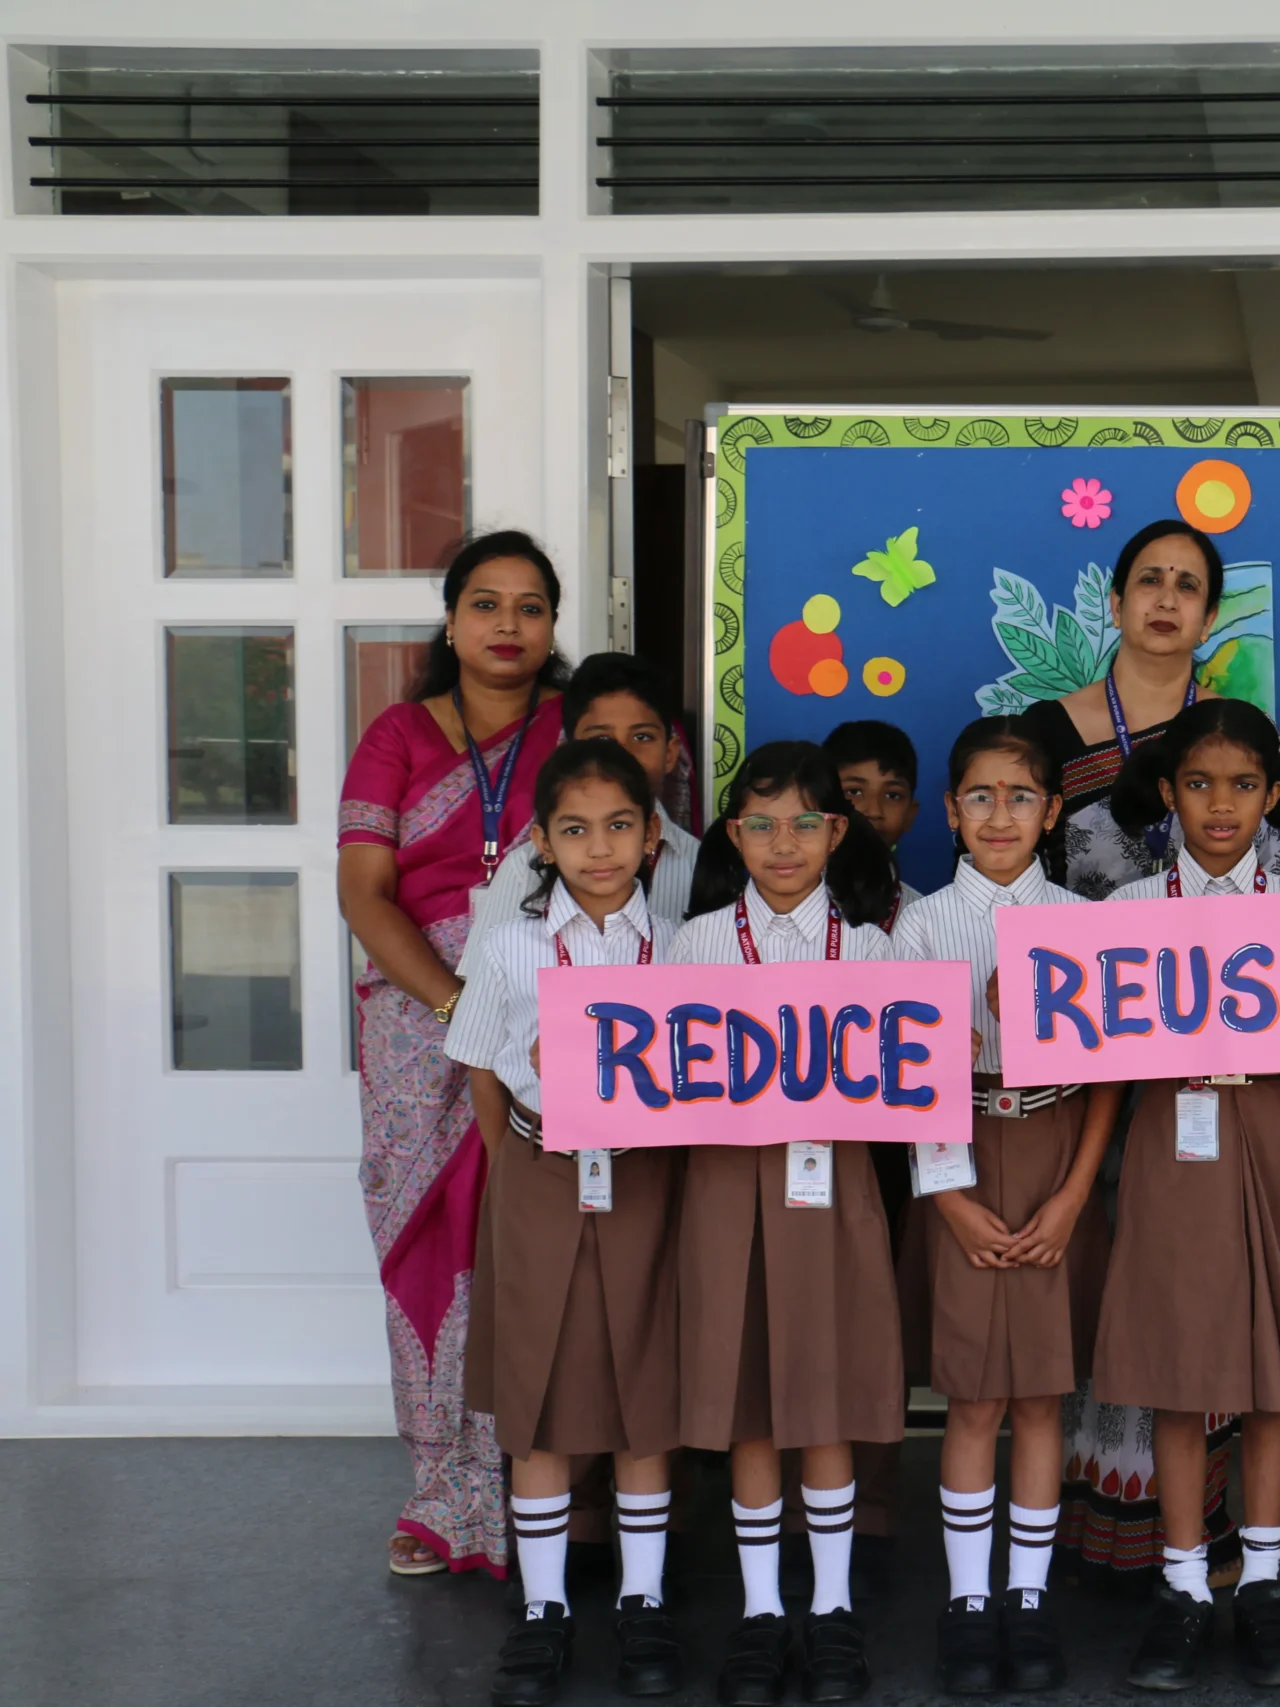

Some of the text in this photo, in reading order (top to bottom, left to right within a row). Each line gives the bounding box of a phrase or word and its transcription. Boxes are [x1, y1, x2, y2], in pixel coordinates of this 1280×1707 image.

[641, 953, 648, 964] KR
[829, 923, 838, 959] KR PURAM
[585, 1000, 942, 1111] REDUCE
